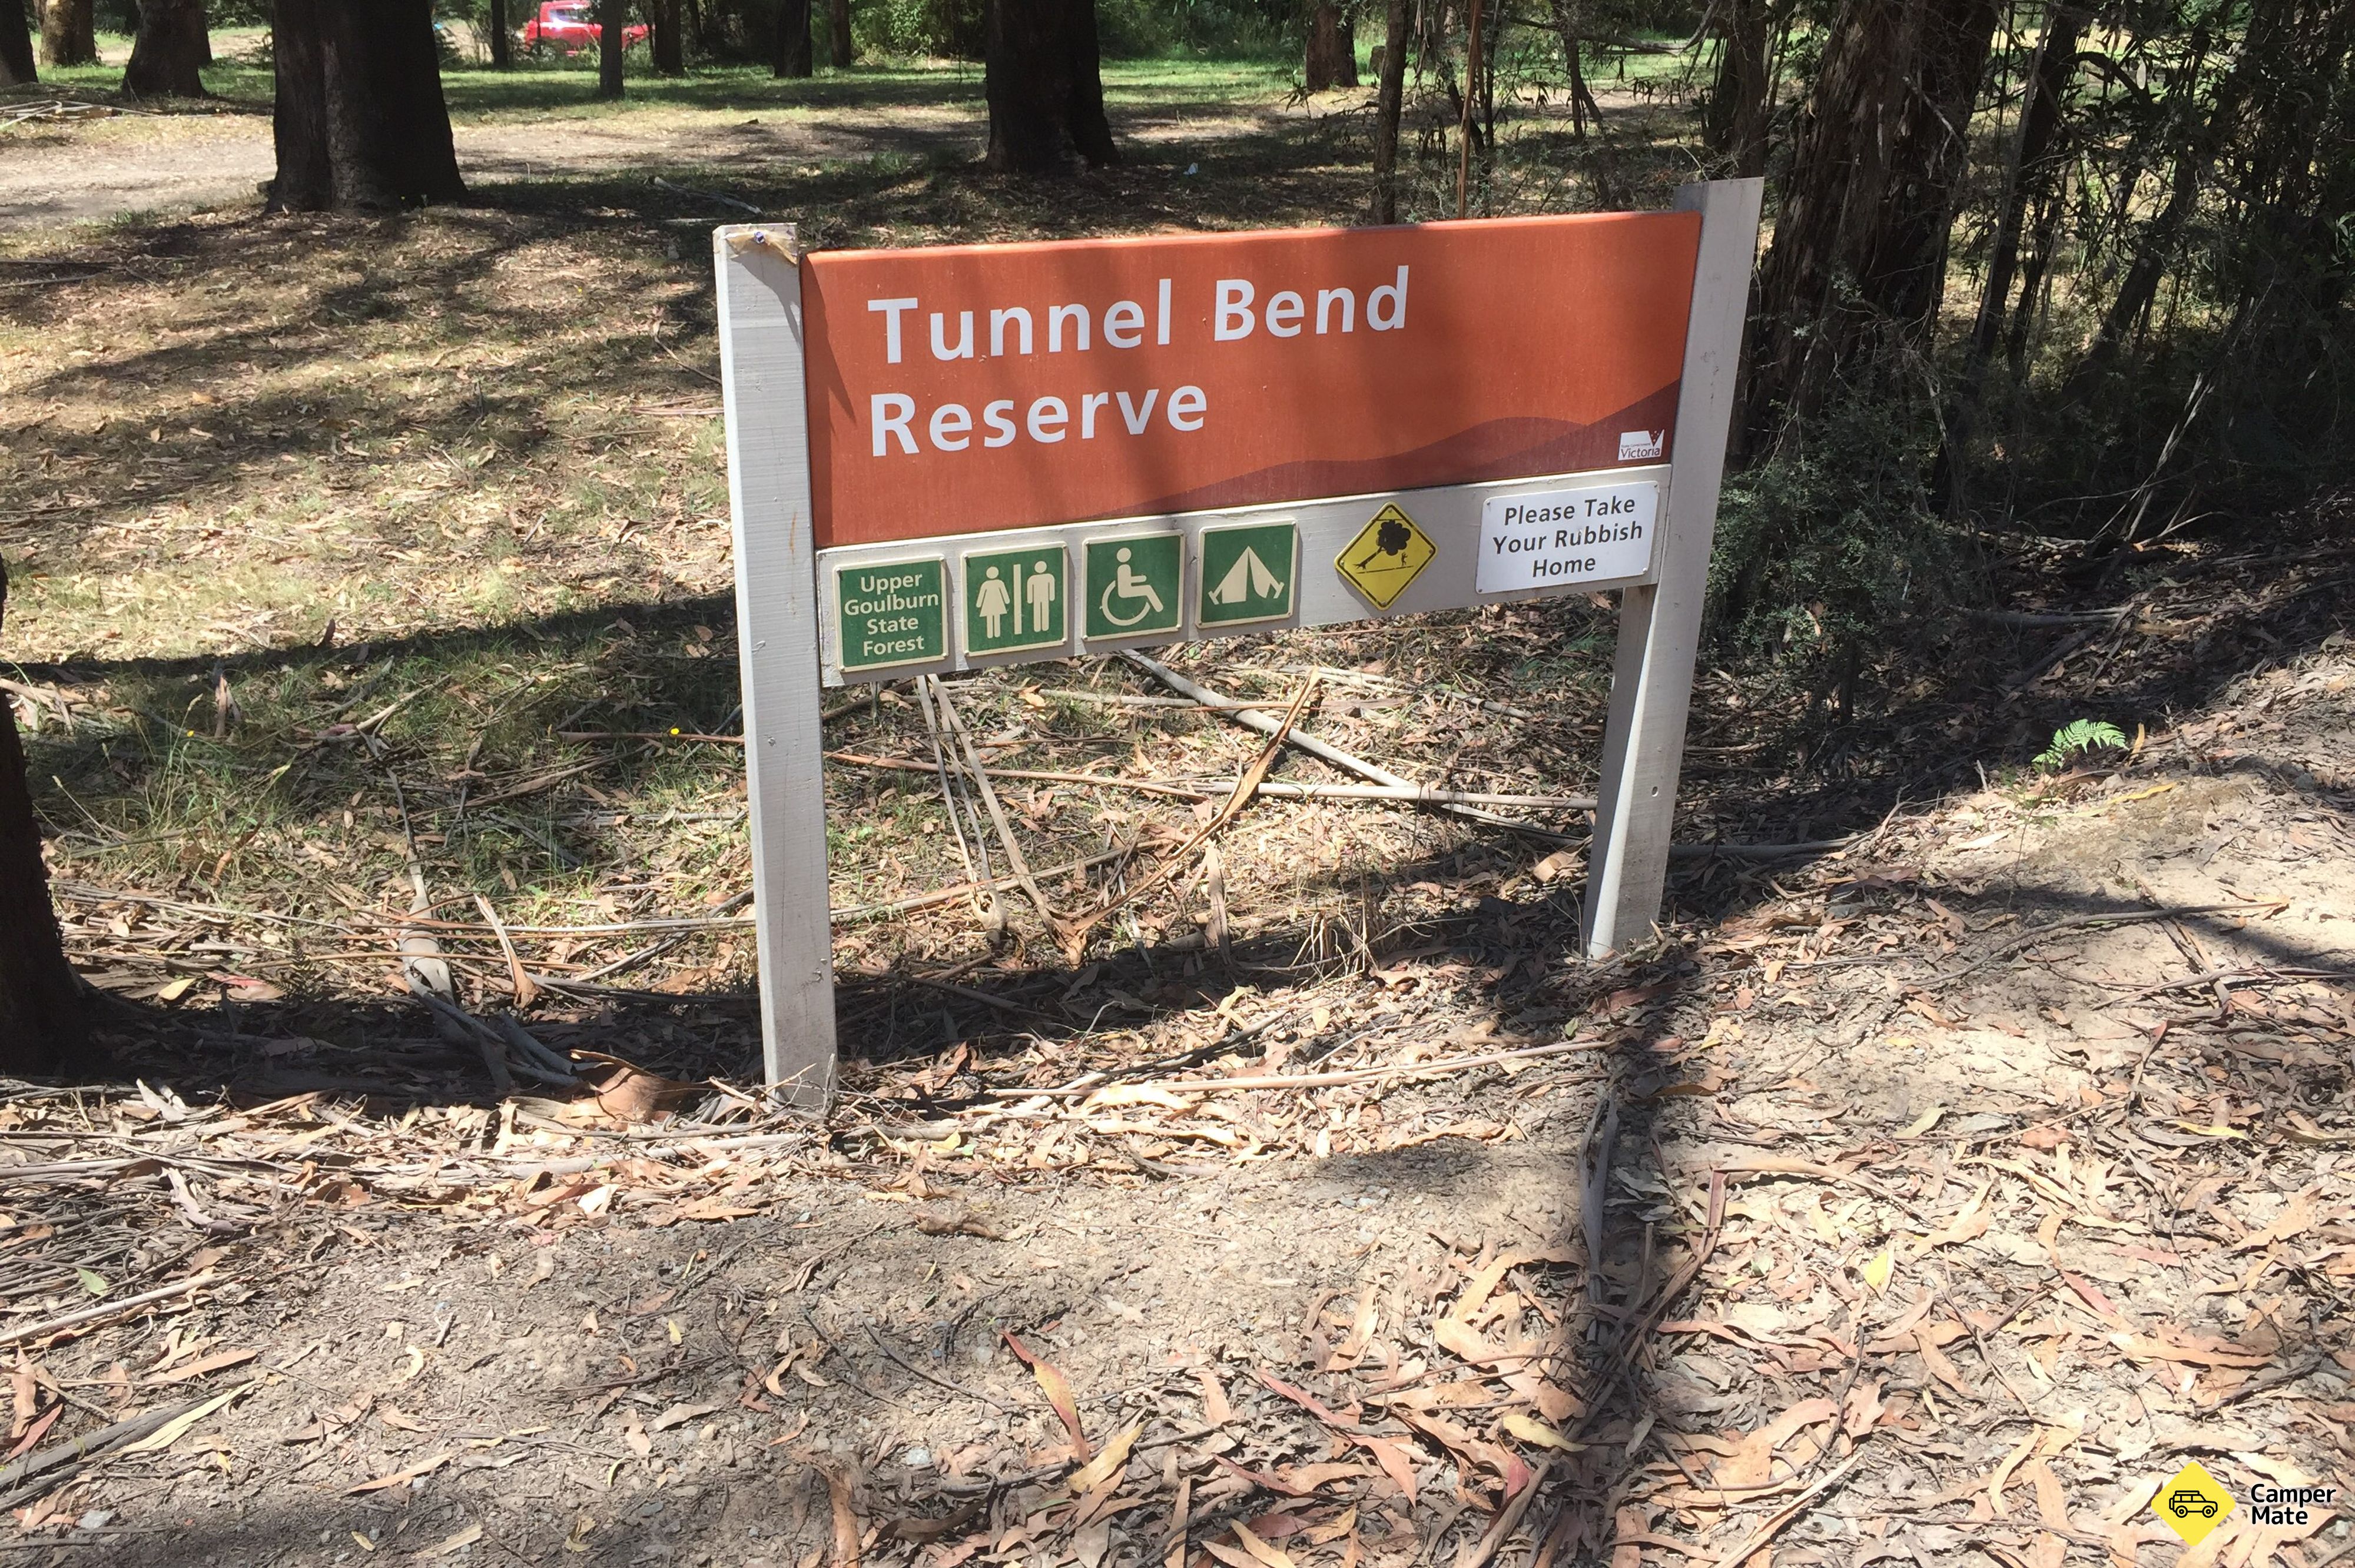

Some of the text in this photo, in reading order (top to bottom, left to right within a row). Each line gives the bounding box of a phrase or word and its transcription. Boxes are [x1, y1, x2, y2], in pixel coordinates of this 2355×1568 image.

[867, 265, 1409, 363] Tunnel Bend
[871, 384, 1207, 457] Reserve
[1621, 448, 1660, 458] Victoria
[1504, 496, 1635, 526] Please Take
[1492, 521, 1642, 554] Your Rubbish
[1533, 557, 1596, 577] Home
[861, 573, 923, 595] Upper
[844, 593, 938, 616] Goulburn
[867, 616, 918, 635] State
[863, 635, 924, 656] Forest
